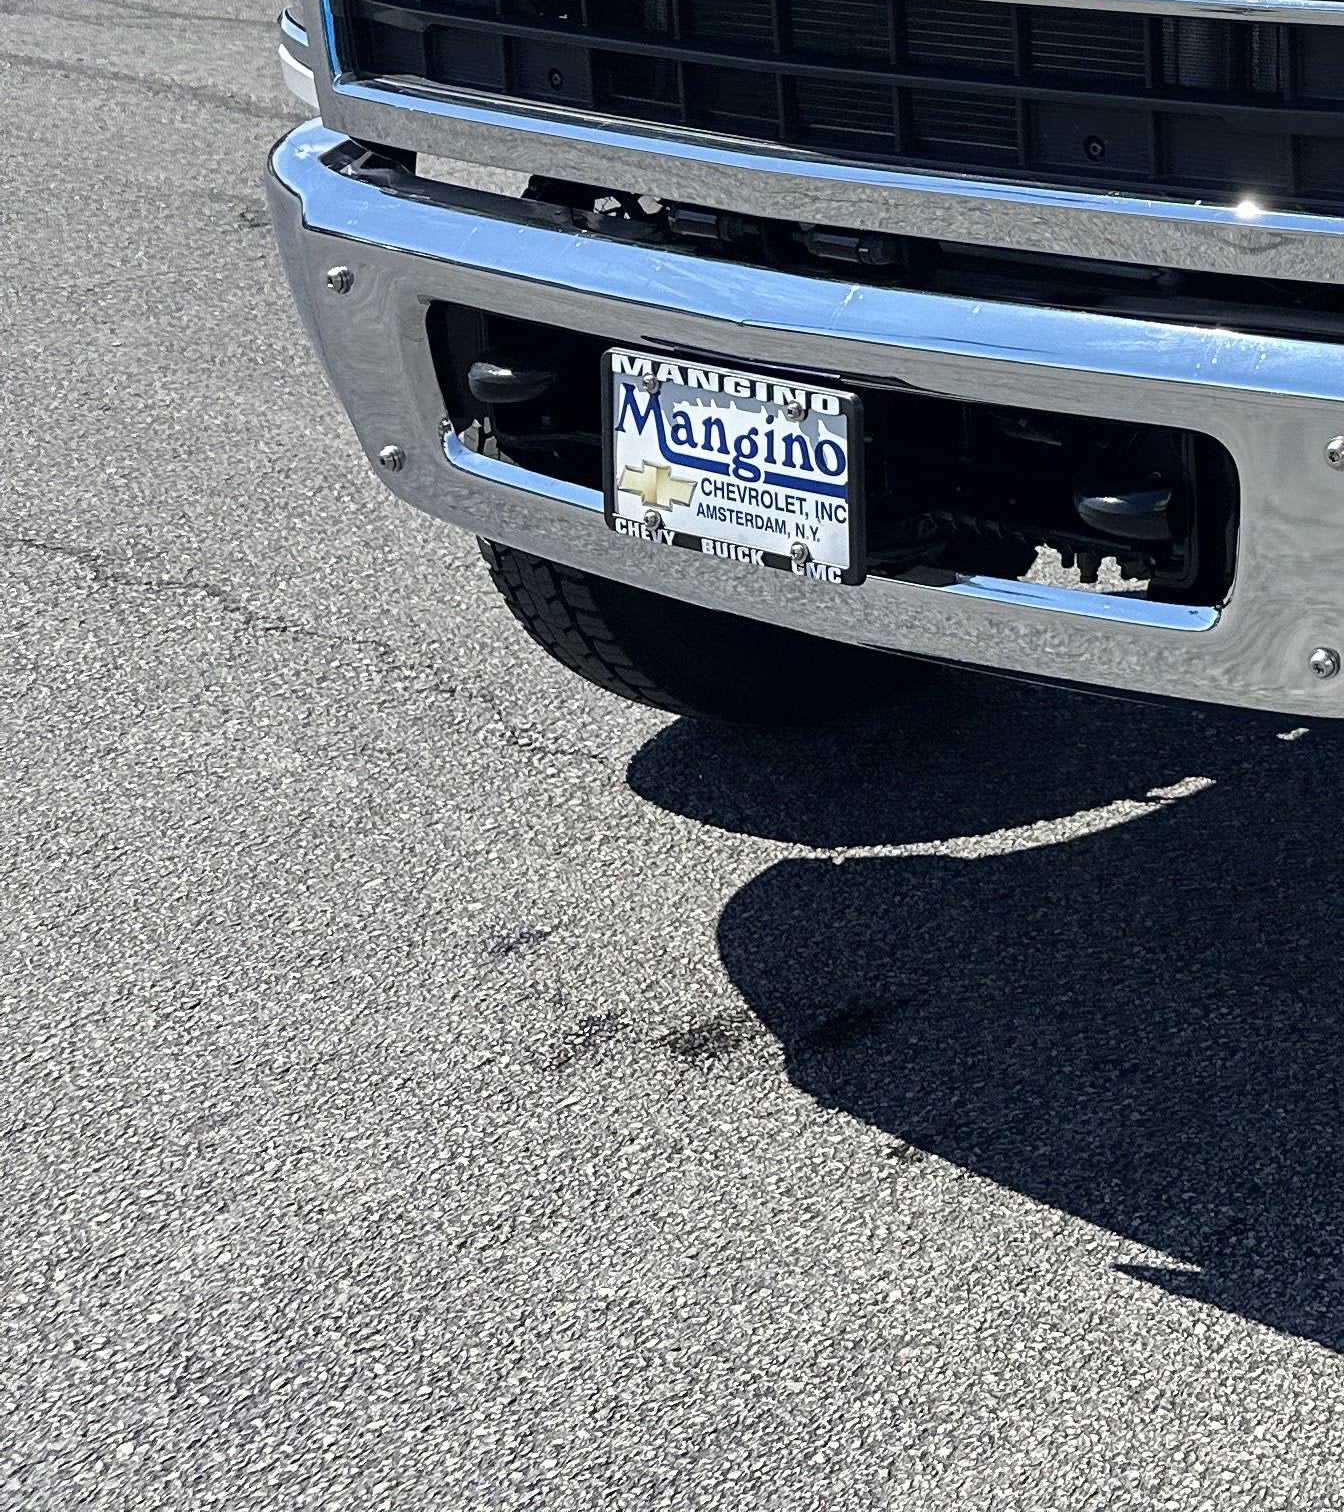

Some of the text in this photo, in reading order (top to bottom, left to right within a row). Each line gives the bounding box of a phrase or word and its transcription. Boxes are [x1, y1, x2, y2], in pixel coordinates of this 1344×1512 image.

[611, 353, 842, 416] MANGINO
[614, 383, 847, 484] Mangino
[696, 502, 791, 539] AMSTERDAM,
[700, 477, 848, 525] CHEVROLET, INC
[614, 517, 676, 547] CHEVY
[700, 538, 765, 567] BUICK
